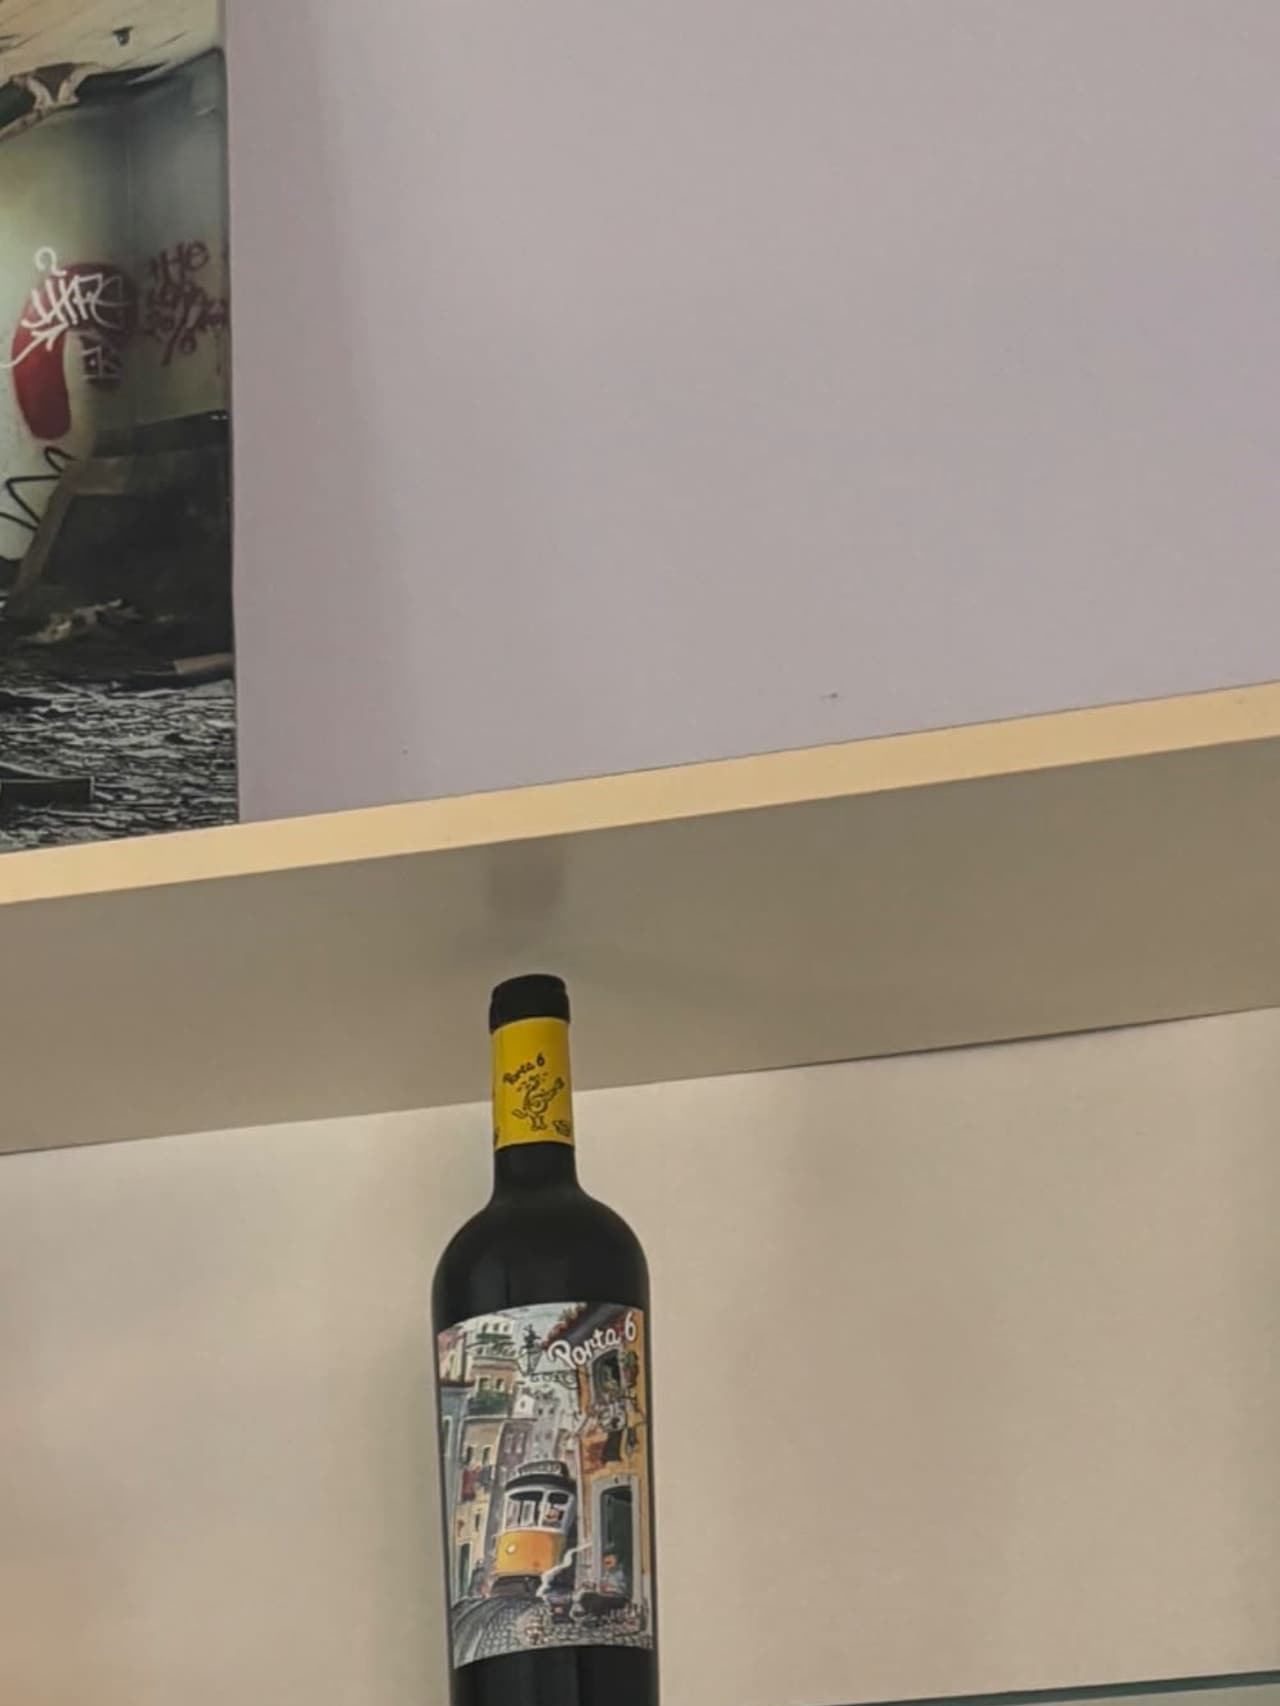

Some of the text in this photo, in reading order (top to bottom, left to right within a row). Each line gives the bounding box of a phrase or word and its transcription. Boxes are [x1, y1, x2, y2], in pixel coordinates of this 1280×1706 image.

[536, 1051, 546, 1068] 6
[547, 1310, 637, 1369] Porta 6
